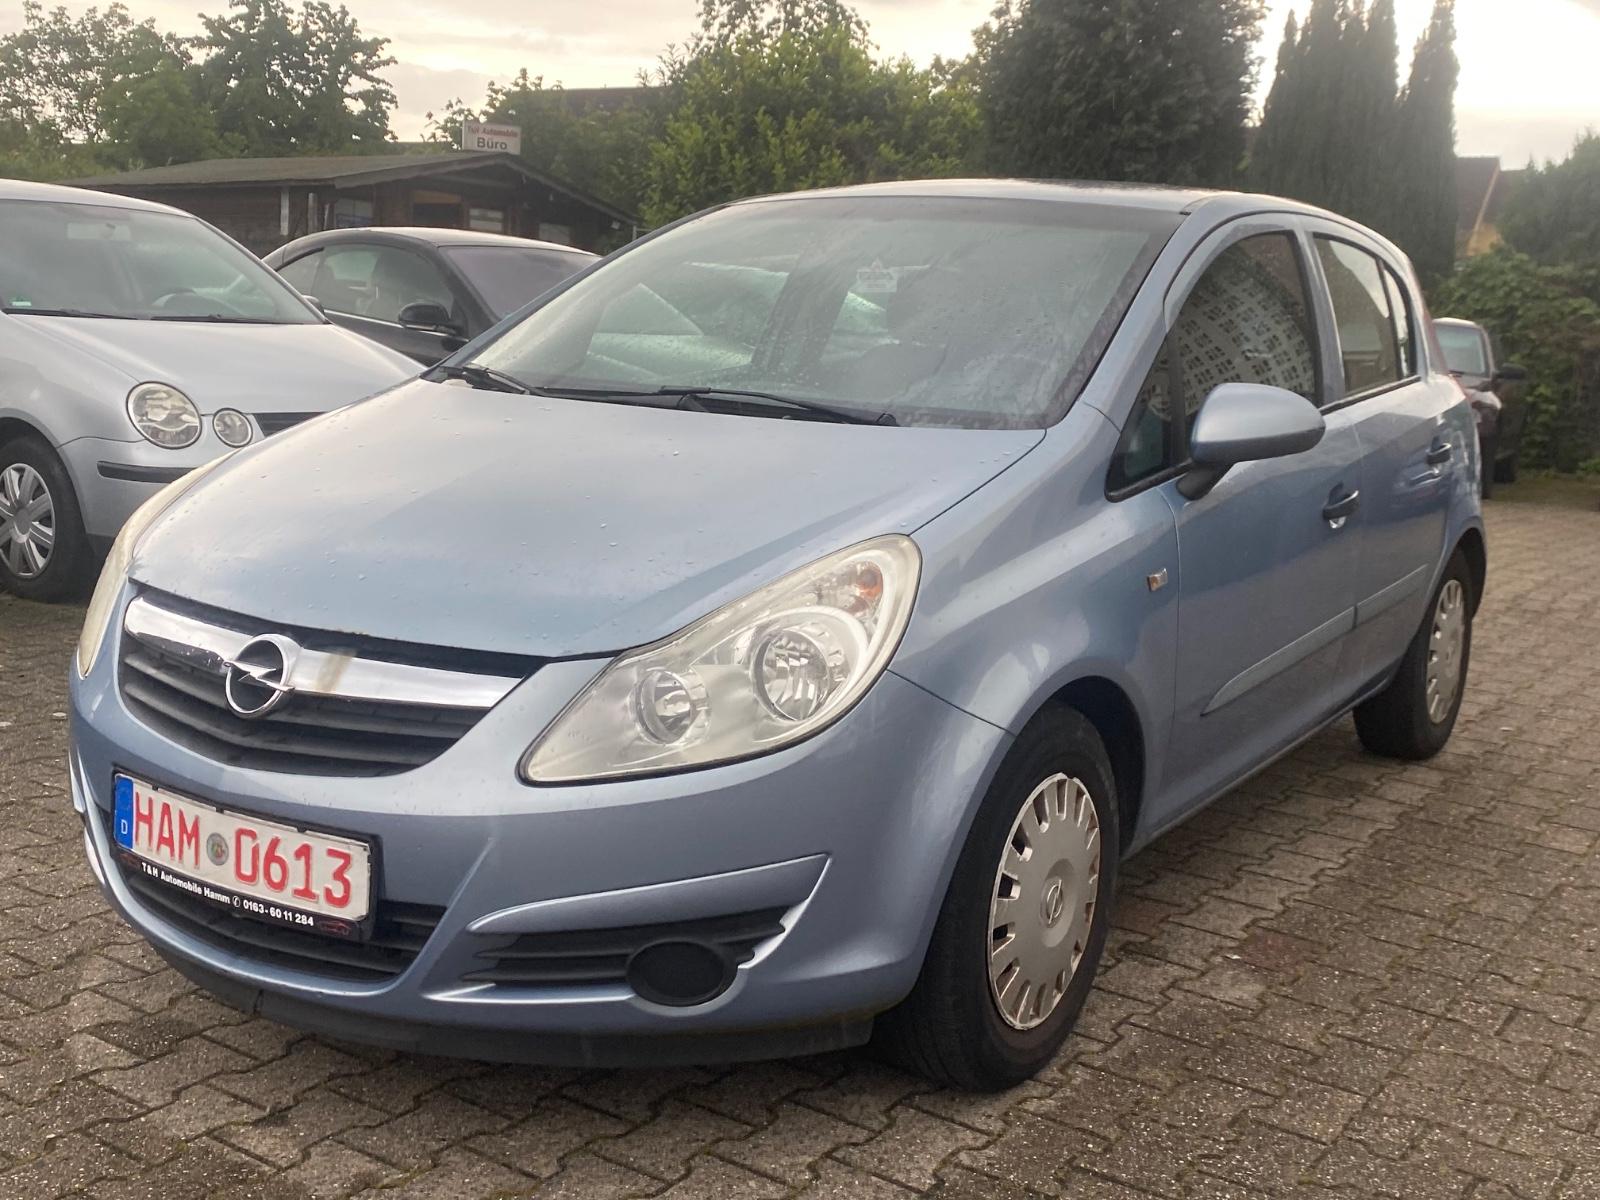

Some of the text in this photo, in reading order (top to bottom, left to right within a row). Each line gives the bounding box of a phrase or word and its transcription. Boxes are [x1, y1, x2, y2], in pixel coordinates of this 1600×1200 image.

[477, 136, 508, 150] Büro
[120, 818, 129, 835] D
[134, 791, 352, 909] HAM 0613
[160, 870, 203, 895] Automobile
[203, 886, 231, 904] Hamm
[294, 913, 314, 926] 284
